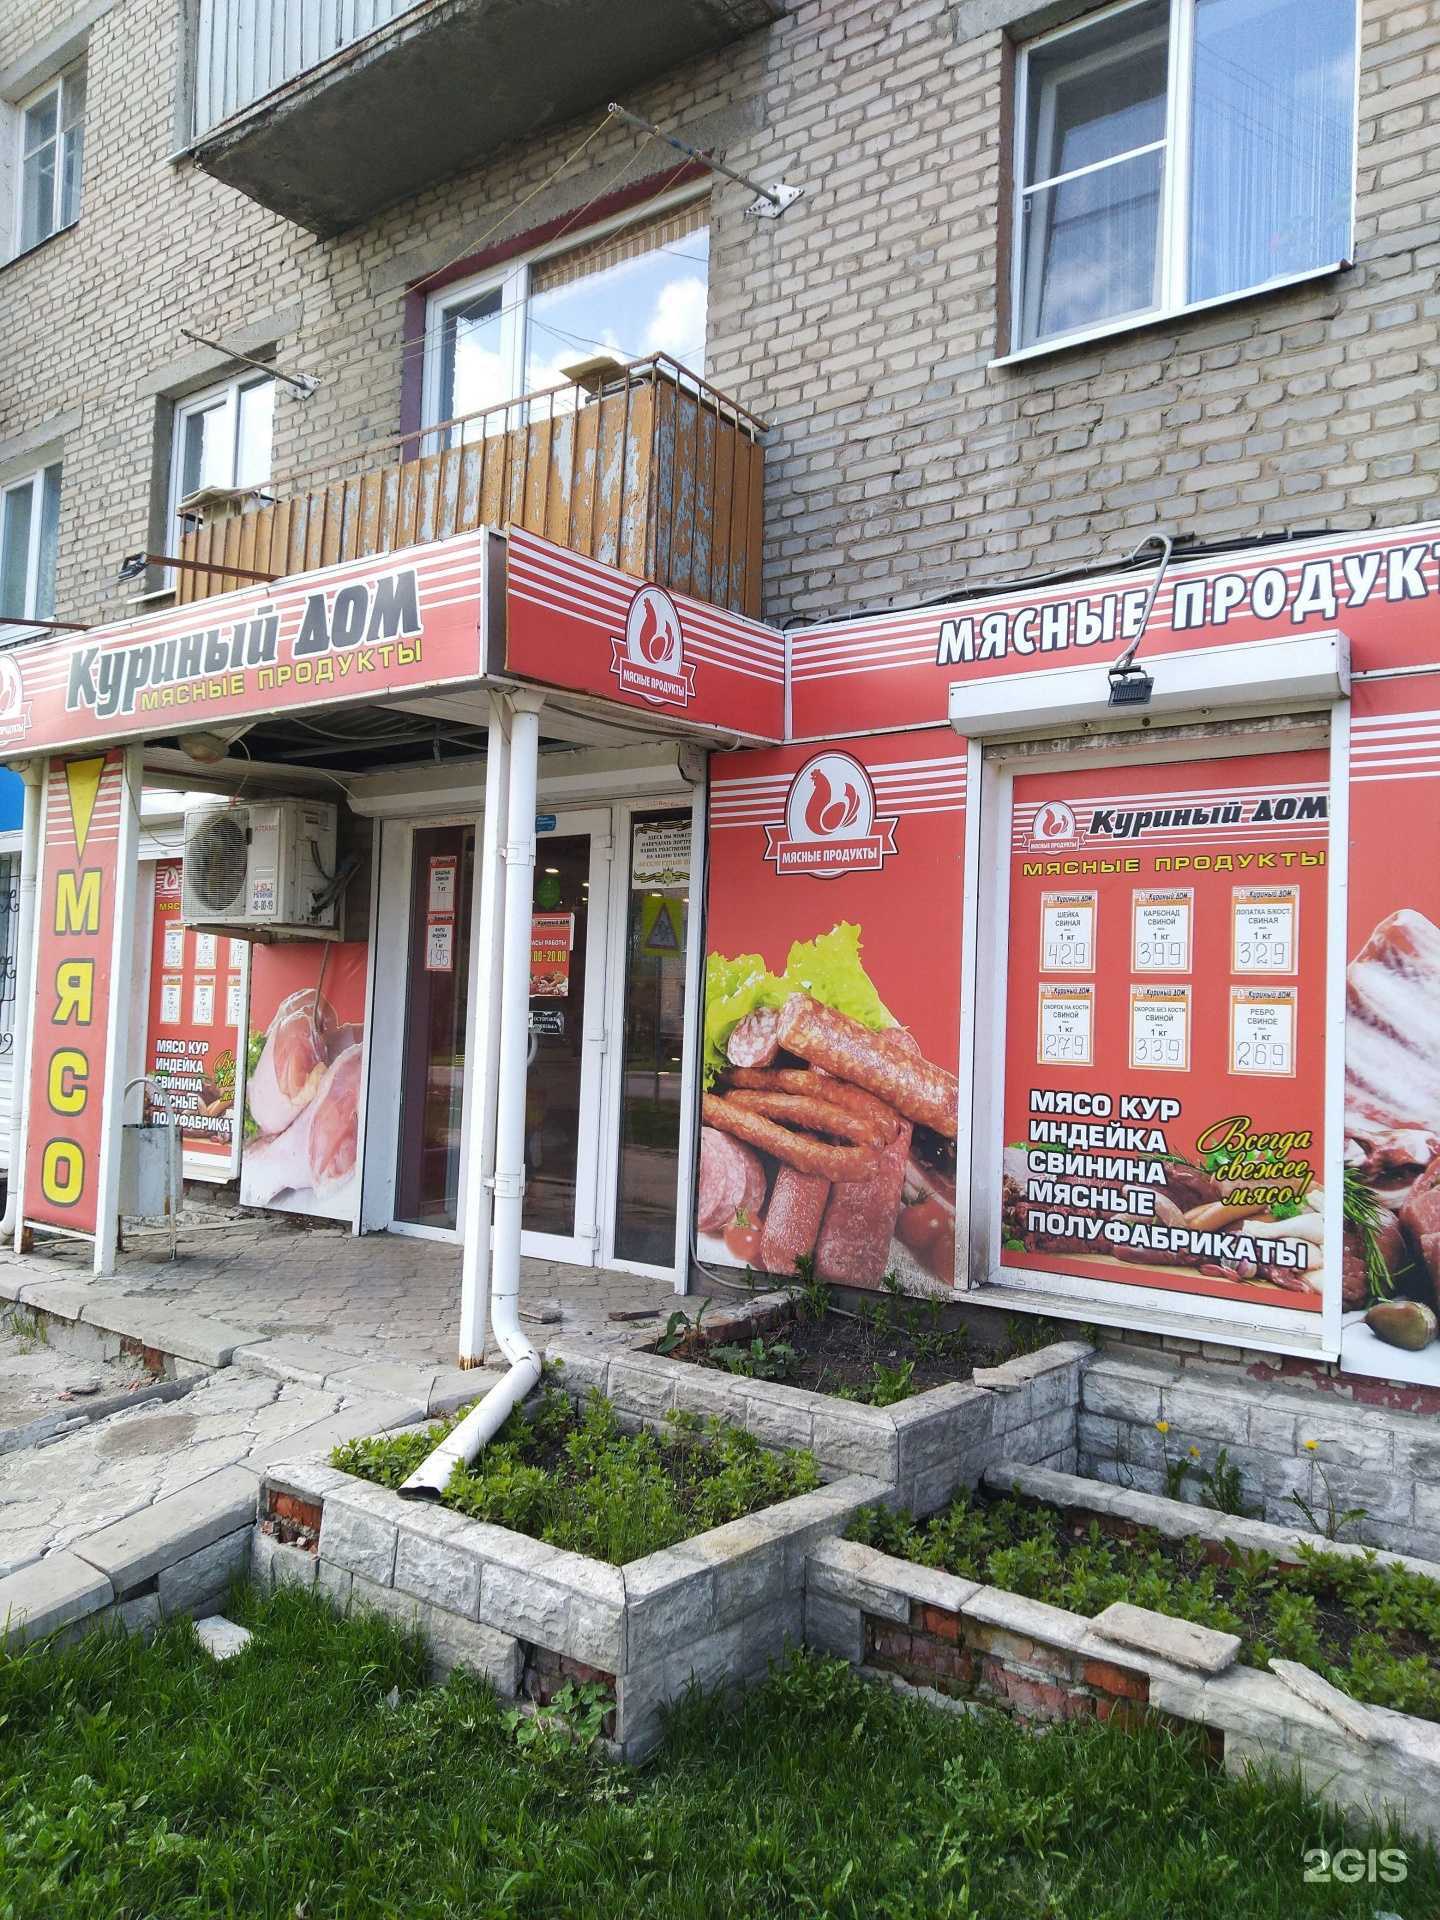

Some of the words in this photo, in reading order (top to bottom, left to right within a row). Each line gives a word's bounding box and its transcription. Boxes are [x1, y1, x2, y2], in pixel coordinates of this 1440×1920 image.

[937, 588, 1149, 666] МЯСНЫЕ
[66, 604, 279, 716] Куриный
[295, 569, 423, 656] ДОМ
[141, 673, 245, 711] МЯСНЫЕ
[258, 640, 423, 691] ПРОДУКТЫ
[623, 669, 650, 688] МЯСНЫЕ
[651, 676, 685, 696] ПРОДУКТЫ
[1089, 801, 1244, 838] Куриный
[1252, 796, 1328, 822] ДОМ
[782, 850, 821, 864] МЯСНЫЕ
[823, 847, 877, 862] ПРОДУКТЫ
[1023, 859, 1141, 876] МЯСНЫЕ
[1154, 851, 1326, 872] ПРОДУКТЫ
[159, 902, 180, 911] МЯС
[1057, 910, 1079, 918] ШЕЙКА
[1144, 909, 1180, 917] КАРБОНАД
[1060, 933, 1064, 941] 1
[532, 950, 567, 962] .00-20.00
[1048, 943, 1085, 965] 429
[1140, 943, 1181, 965] 399
[1240, 942, 1284, 965] 329
[1250, 1008, 1275, 1016] РЕБРО
[41, 866, 102, 1208] МЯСО
[156, 1039, 186, 1053] МЯСО
[188, 1041, 209, 1055] КУР
[1046, 1034, 1084, 1056] 279
[1136, 1038, 1180, 1061] 339
[1237, 1042, 1284, 1065] 269
[155, 1057, 204, 1073] ИНДЕЙКА
[155, 1075, 203, 1092] СВИНИНА
[153, 1093, 198, 1110] МСНЫЕ
[1029, 1089, 1111, 1117] МЯСО
[1120, 1095, 1180, 1122] КУР
[1029, 1119, 1168, 1153] ИНДЕЙКА
[1196, 1115, 1312, 1158] Всегда
[1028, 1151, 1167, 1185] СВИНИНА
[1215, 1158, 1308, 1182] свежее
[1027, 1180, 1156, 1216] МЯСНЫЕ
[1221, 1171, 1313, 1206] мясо!
[1027, 1210, 1308, 1268] ПОЛУФАБРИКАТЫ
